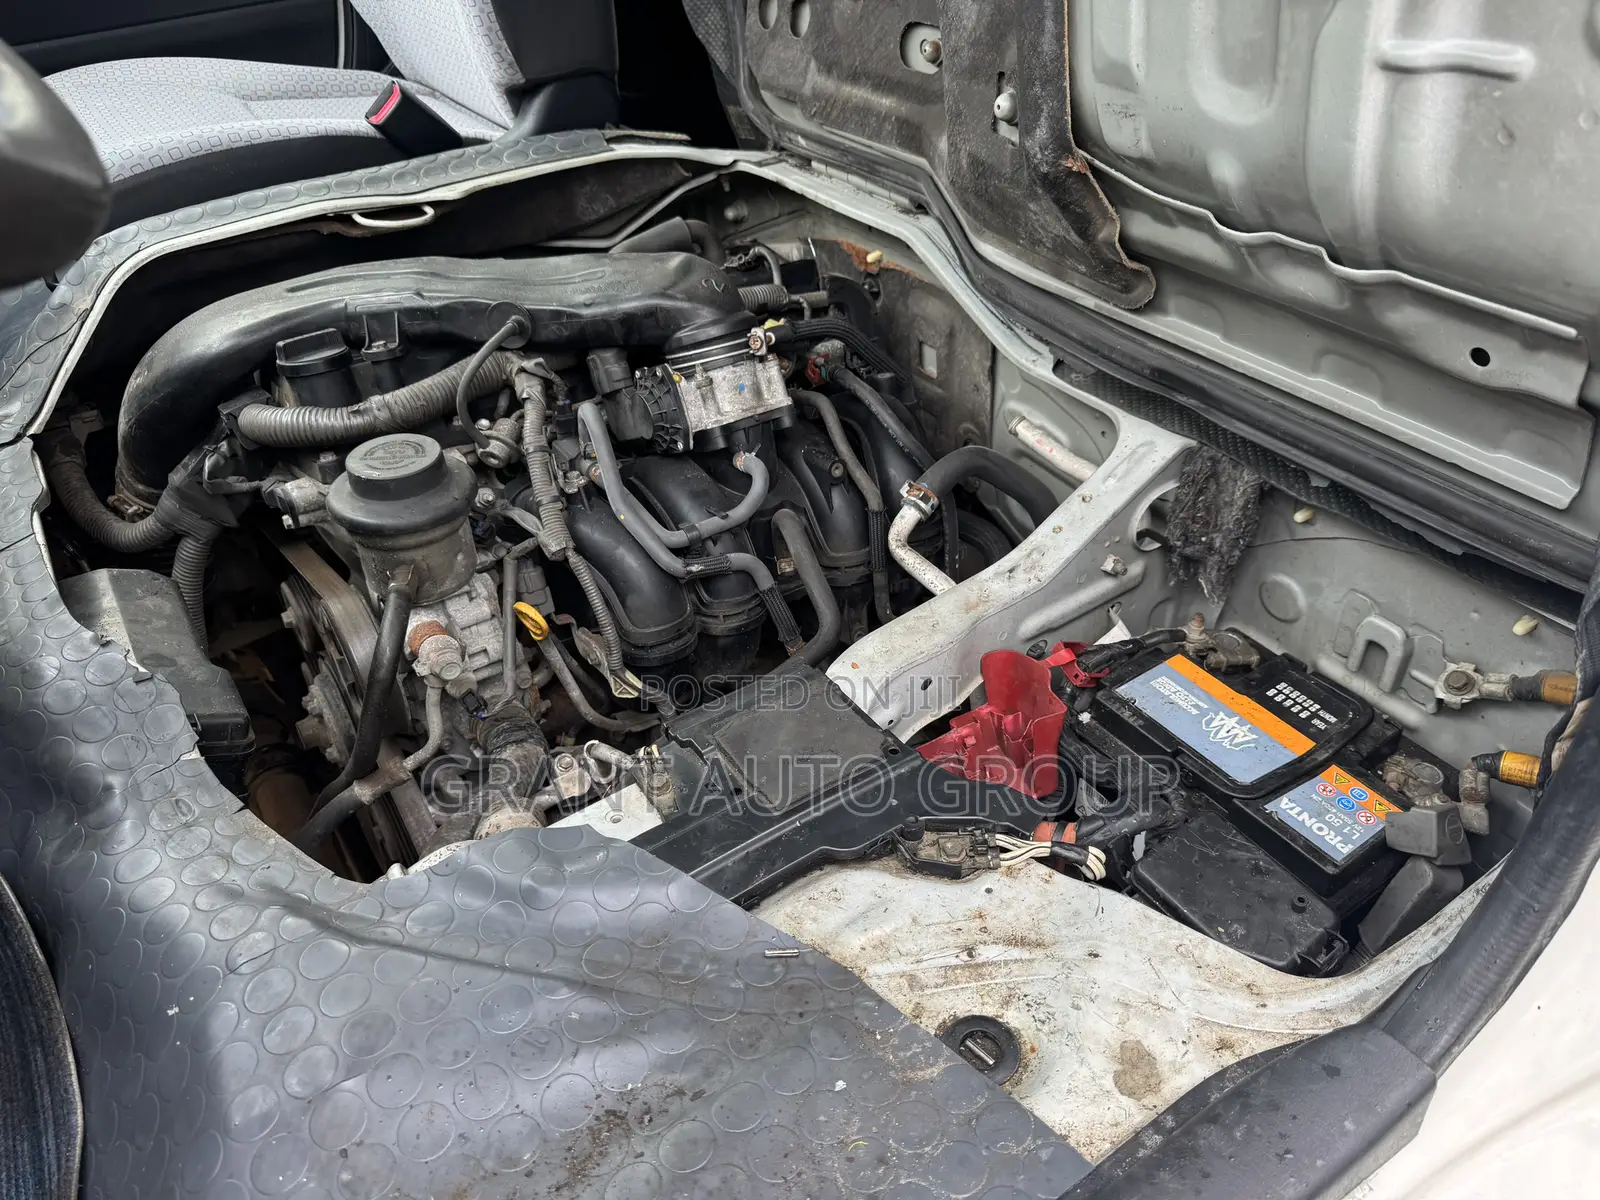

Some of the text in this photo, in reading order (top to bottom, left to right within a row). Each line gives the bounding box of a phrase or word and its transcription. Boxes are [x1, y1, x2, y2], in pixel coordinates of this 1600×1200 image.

[1311, 718, 1328, 730] YEAR
[1279, 796, 1355, 855] PRONTA
[1325, 813, 1343, 827] 50
